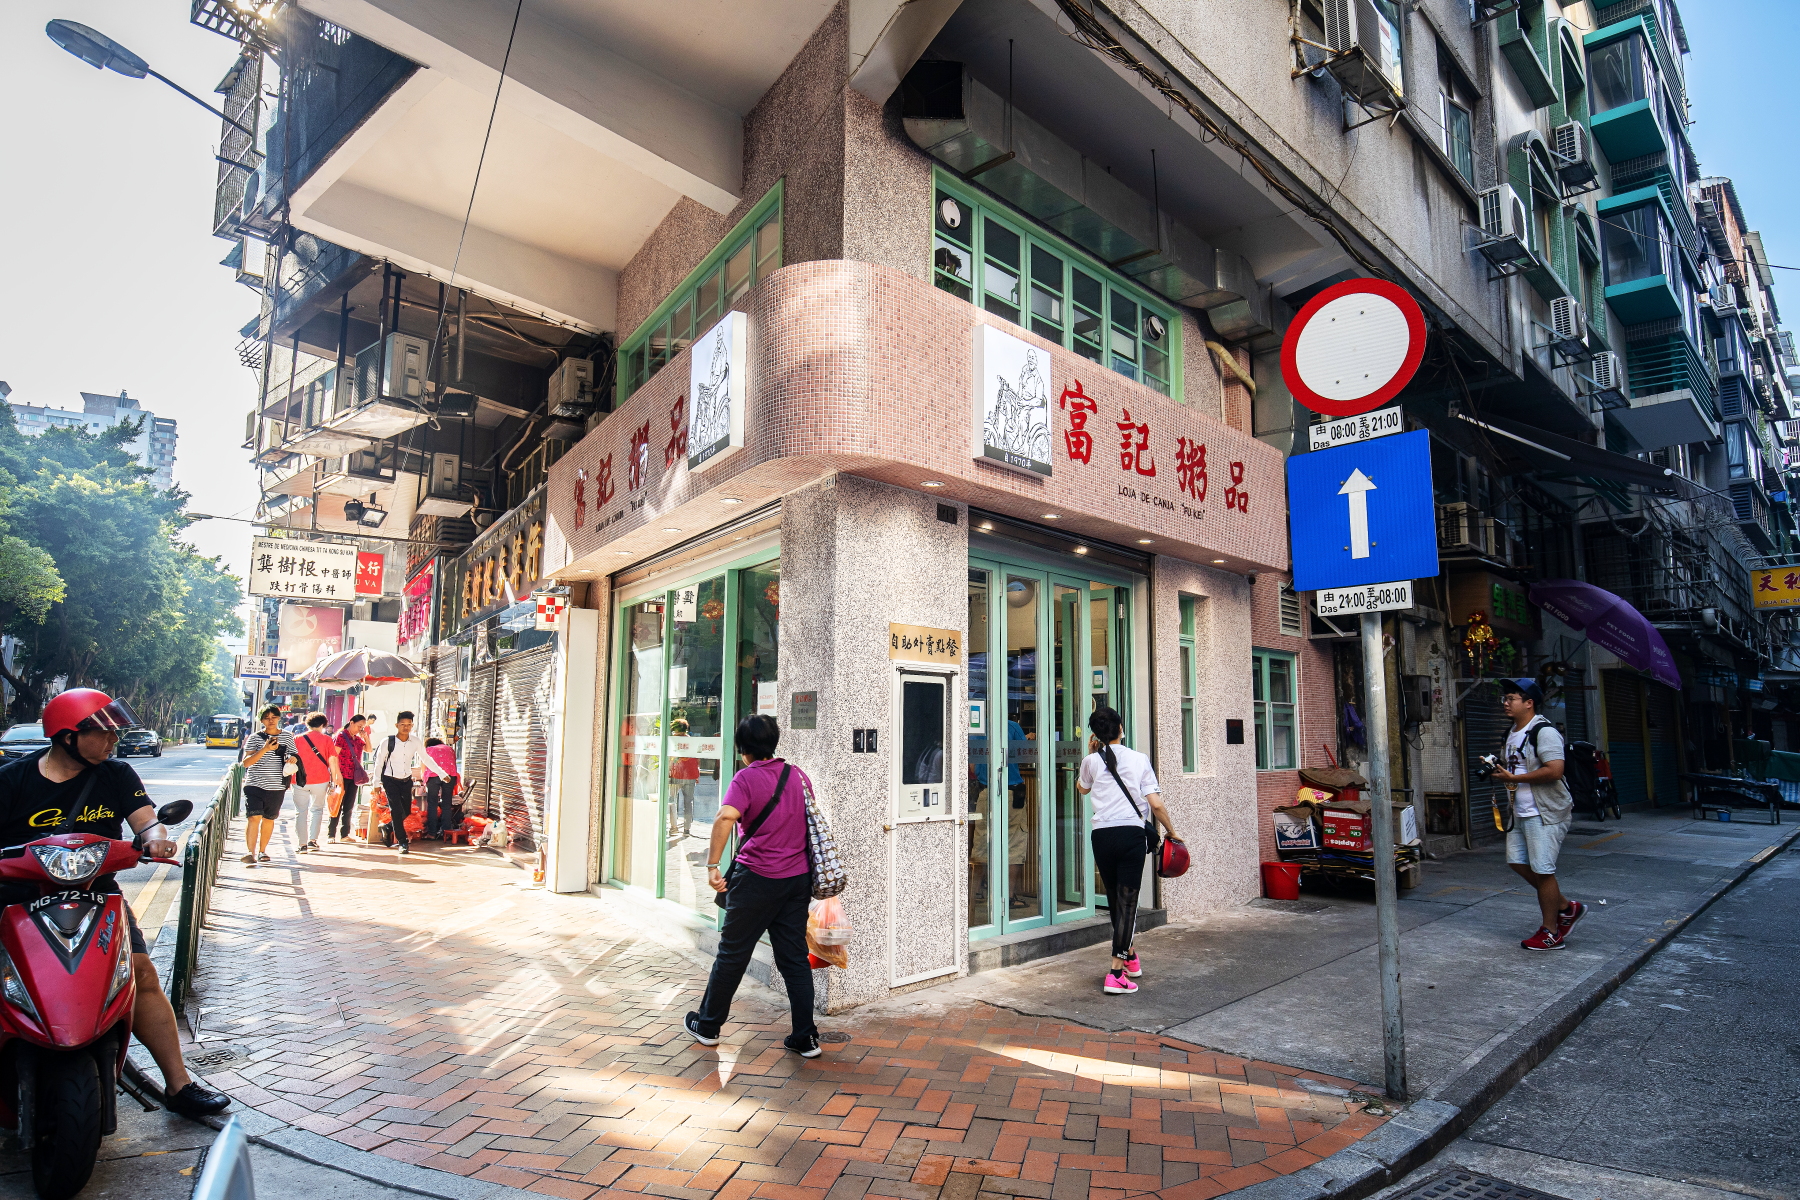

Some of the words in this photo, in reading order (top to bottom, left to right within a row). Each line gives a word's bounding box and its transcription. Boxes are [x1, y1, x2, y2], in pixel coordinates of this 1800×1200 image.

[1316, 425, 1326, 435] 由
[1331, 422, 1356, 440] 08:00
[1359, 417, 1368, 428] 至
[1372, 412, 1398, 431] 21:00
[1060, 379, 1248, 514] 富記粥品
[1313, 441, 1330, 449] Das
[574, 395, 688, 530] 富記粥品
[1005, 452, 1031, 469] 自1970年
[1118, 485, 1136, 499] LOJA
[1141, 493, 1150, 503] DE
[1154, 497, 1174, 511] CANJA
[280, 543, 298, 551] MEDICINA
[299, 545, 315, 553] CHINESA
[257, 554, 318, 577] 龔樹根
[321, 568, 352, 580] 中醫師
[1324, 592, 1334, 602] 由
[1339, 592, 1365, 608] 21:00
[1367, 587, 1375, 598] 至
[1380, 587, 1406, 604] 08:00
[1544, 602, 1555, 612] PET
[1554, 607, 1570, 622] FOOD
[1606, 622, 1618, 632] PET
[1619, 630, 1635, 642] FOOD
[892, 633, 959, 657] 自助外賣點餐
[1330, 839, 1356, 848] Apples
[30, 890, 105, 912] MG-72-18
